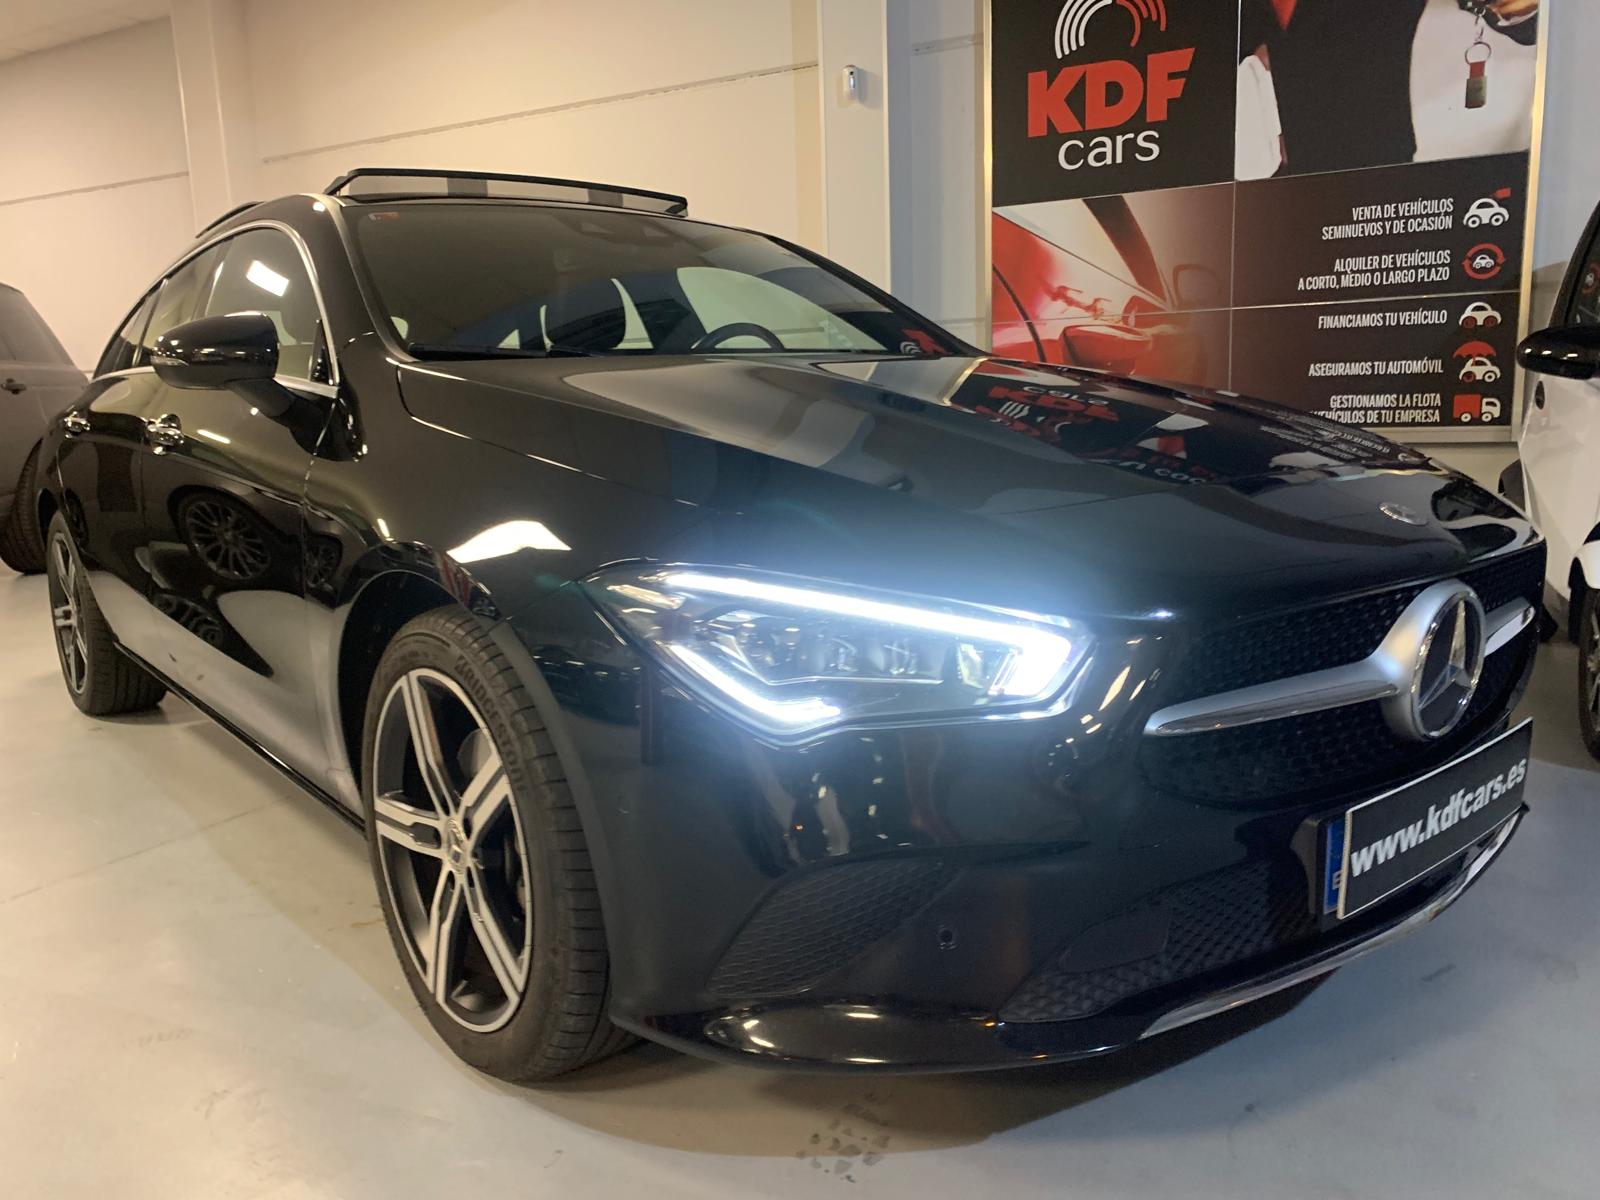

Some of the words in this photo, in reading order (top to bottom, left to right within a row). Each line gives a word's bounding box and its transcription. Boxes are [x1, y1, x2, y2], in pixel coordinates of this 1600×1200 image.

[1027, 47, 1196, 138] KDF
[1058, 130, 1160, 170] cars
[1352, 205, 1382, 221] VENTA
[1384, 203, 1397, 218] DE
[1398, 198, 1454, 217] VEHÍCULOS
[1322, 222, 1383, 240] SEMINUEVOS
[1385, 220, 1392, 235] Y
[1393, 219, 1406, 234] DE
[1407, 213, 1453, 233] OCASIÓN
[1334, 255, 1380, 274] ALQUILER
[1381, 254, 1395, 269] DE
[1395, 249, 1451, 267] VEHÍCULOS
[1297, 278, 1304, 291] A
[1306, 275, 1339, 290] CORTO,
[1340, 272, 1372, 288] MEDIO
[1373, 271, 1381, 286] O
[1382, 269, 1416, 285] LARGO
[1417, 266, 1450, 282] PLAZO
[1318, 312, 1384, 329] FINANCIAMOS
[1385, 312, 1398, 326] TU
[1399, 307, 1448, 325] VEHÍCULO
[1308, 361, 1373, 377] ASEGURAMOS
[1374, 361, 1386, 375] TU
[1387, 356, 1444, 375] AUTOMÓVIL
[1330, 393, 1397, 408] GESTIONAMOS
[1399, 393, 1411, 407] LA
[1412, 392, 1441, 407] FLOTA
[1366, 410, 1379, 423] DE
[1380, 410, 1393, 423] TU
[1394, 409, 1440, 422] EMPRESA
[1351, 758, 1527, 878] www.kdfcars.es
